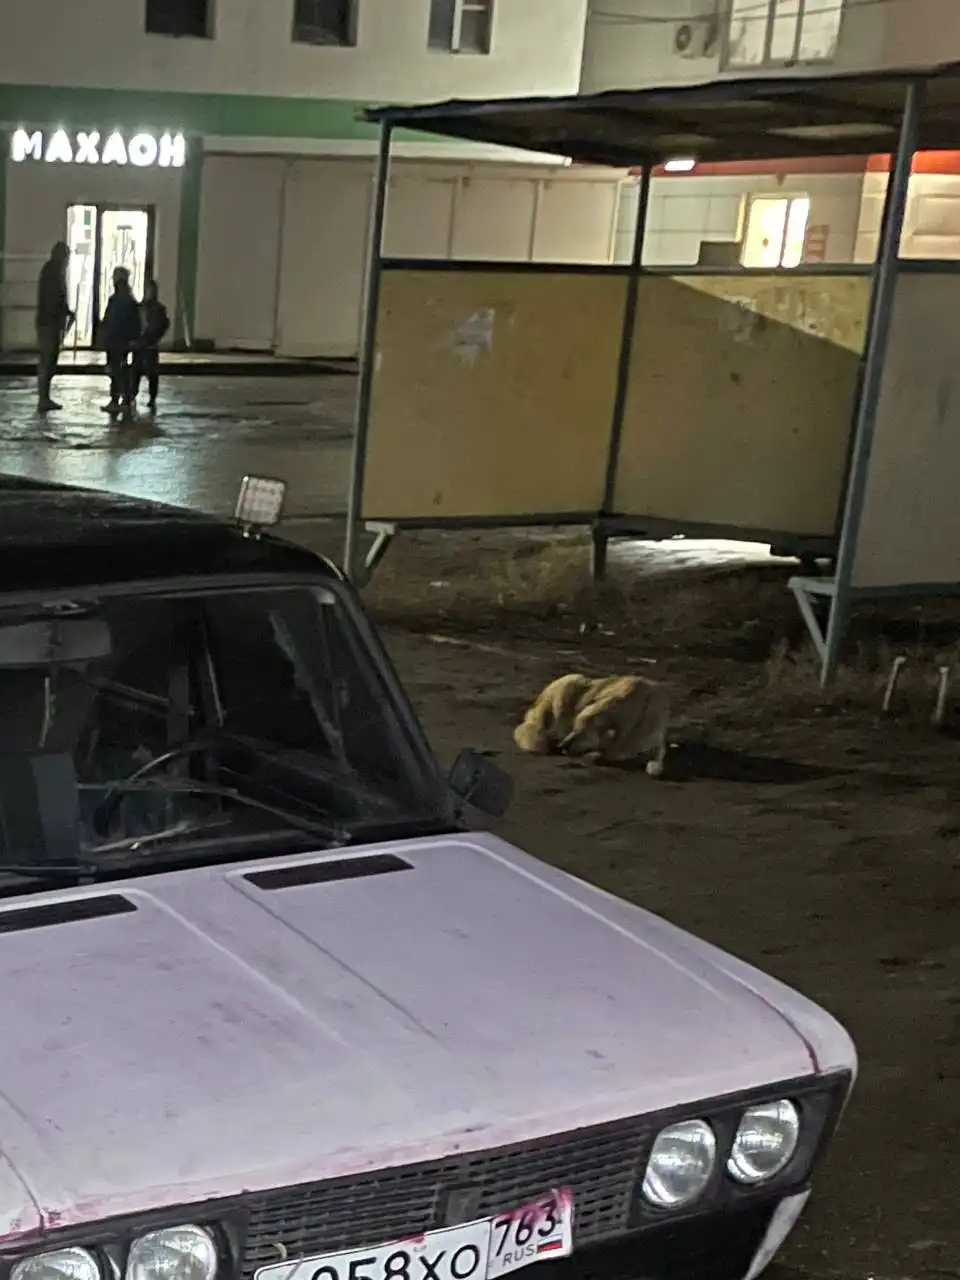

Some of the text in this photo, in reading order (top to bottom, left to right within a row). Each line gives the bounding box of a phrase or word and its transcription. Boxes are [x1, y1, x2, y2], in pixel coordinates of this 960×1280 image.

[12, 128, 186, 167] МАХАОН
[494, 1199, 558, 1257] 763
[502, 1243, 535, 1267] RUS
